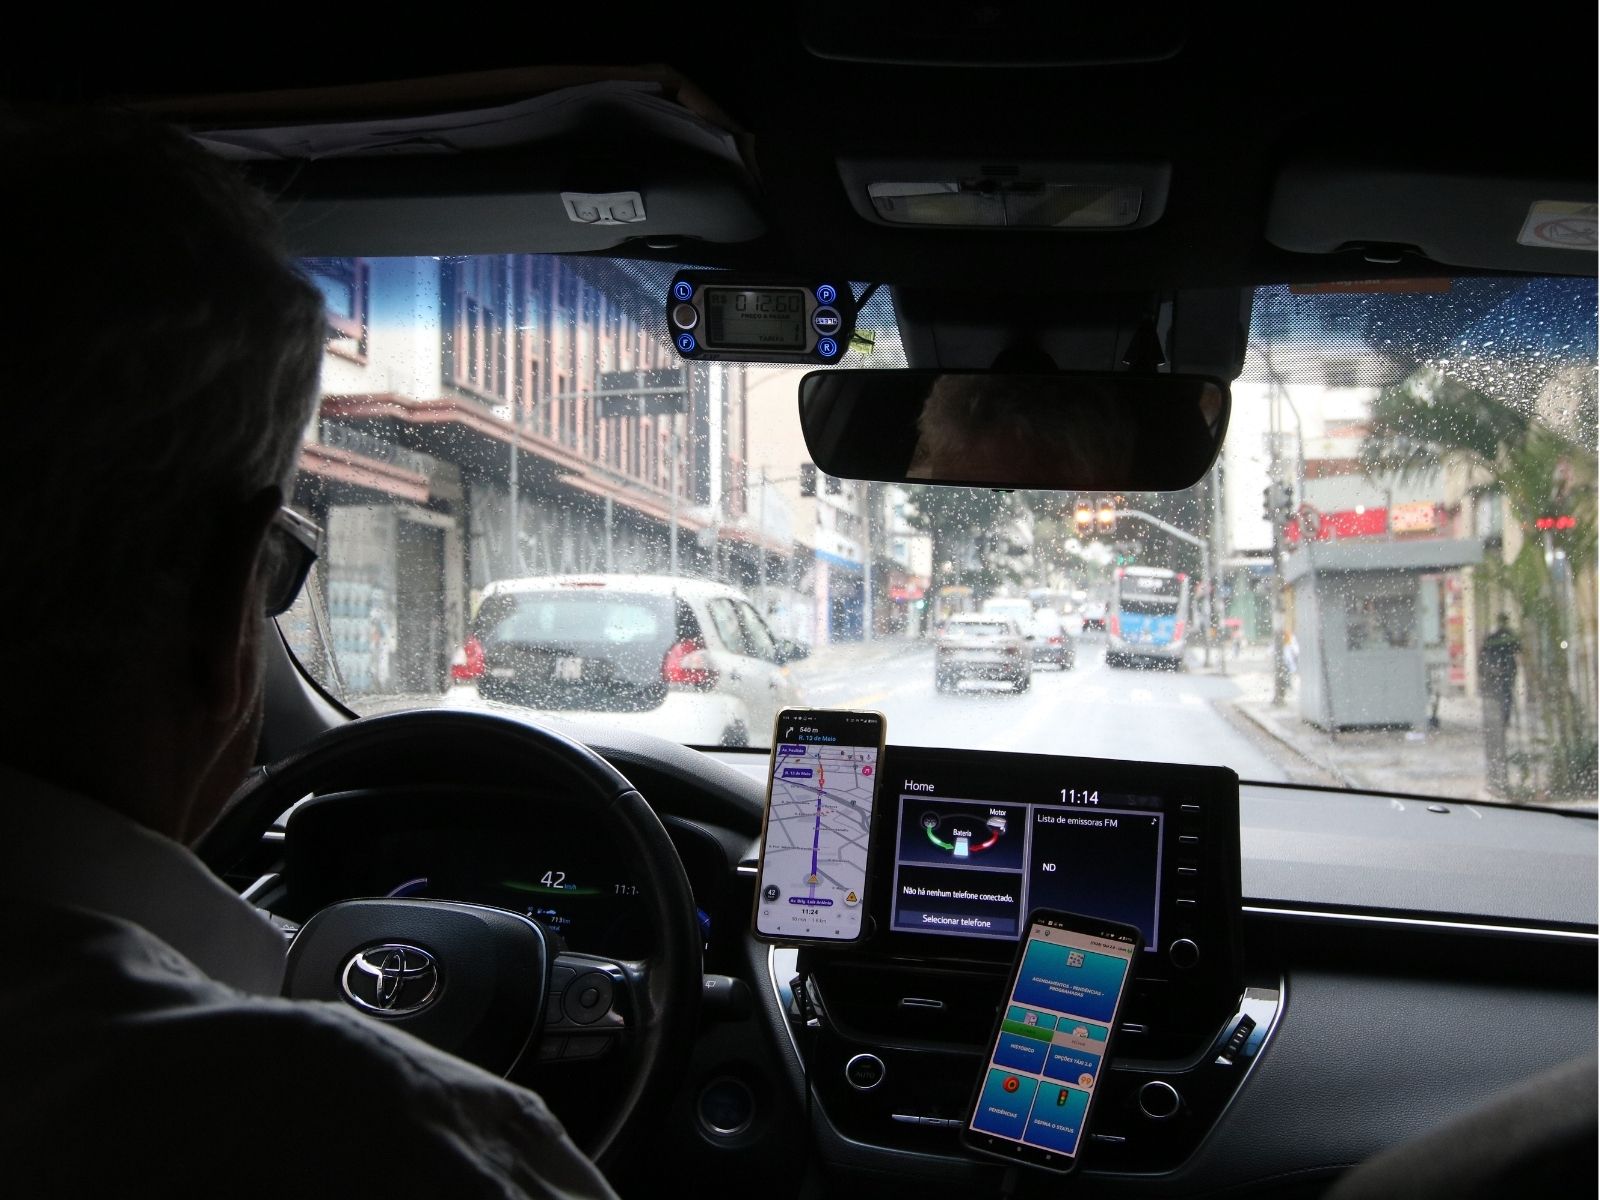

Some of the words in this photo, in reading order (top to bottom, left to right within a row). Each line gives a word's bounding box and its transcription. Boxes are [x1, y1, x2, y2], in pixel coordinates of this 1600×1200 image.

[904, 779, 935, 792] Home
[1060, 788, 1099, 804] 11:14
[989, 807, 1007, 816] Motor
[1037, 814, 1055, 823] Lista
[1056, 816, 1066, 824] de
[1067, 818, 1103, 827] emissoras
[1104, 818, 1118, 828] FM
[952, 828, 972, 837] Bateria
[1042, 862, 1056, 872] ND
[540, 870, 566, 889] 42
[613, 883, 640, 896] 11:1
[902, 885, 917, 895] Não
[917, 887, 926, 896] há
[926, 888, 952, 898] nenhum
[952, 890, 979, 900] telefone
[979, 892, 1014, 903] conectado.
[922, 914, 959, 925] Selecionar
[960, 918, 991, 928] telefone
[1031, 976, 1069, 989] AGENDAMENTOS
[1072, 984, 1101, 996] PENDÊNCIAS
[1049, 985, 1084, 998] PROGRAMADAS
[1010, 1043, 1035, 1054] HISTÓRICO
[1054, 1054, 1073, 1064] OPÇÕES
[1073, 1058, 1085, 1066] TÁXI
[1081, 1076, 1091, 1084] 99
[988, 1106, 1018, 1119] PENDÊNCIAS
[1033, 1118, 1051, 1128] DEFINA
[1056, 1124, 1074, 1134] STATUS
